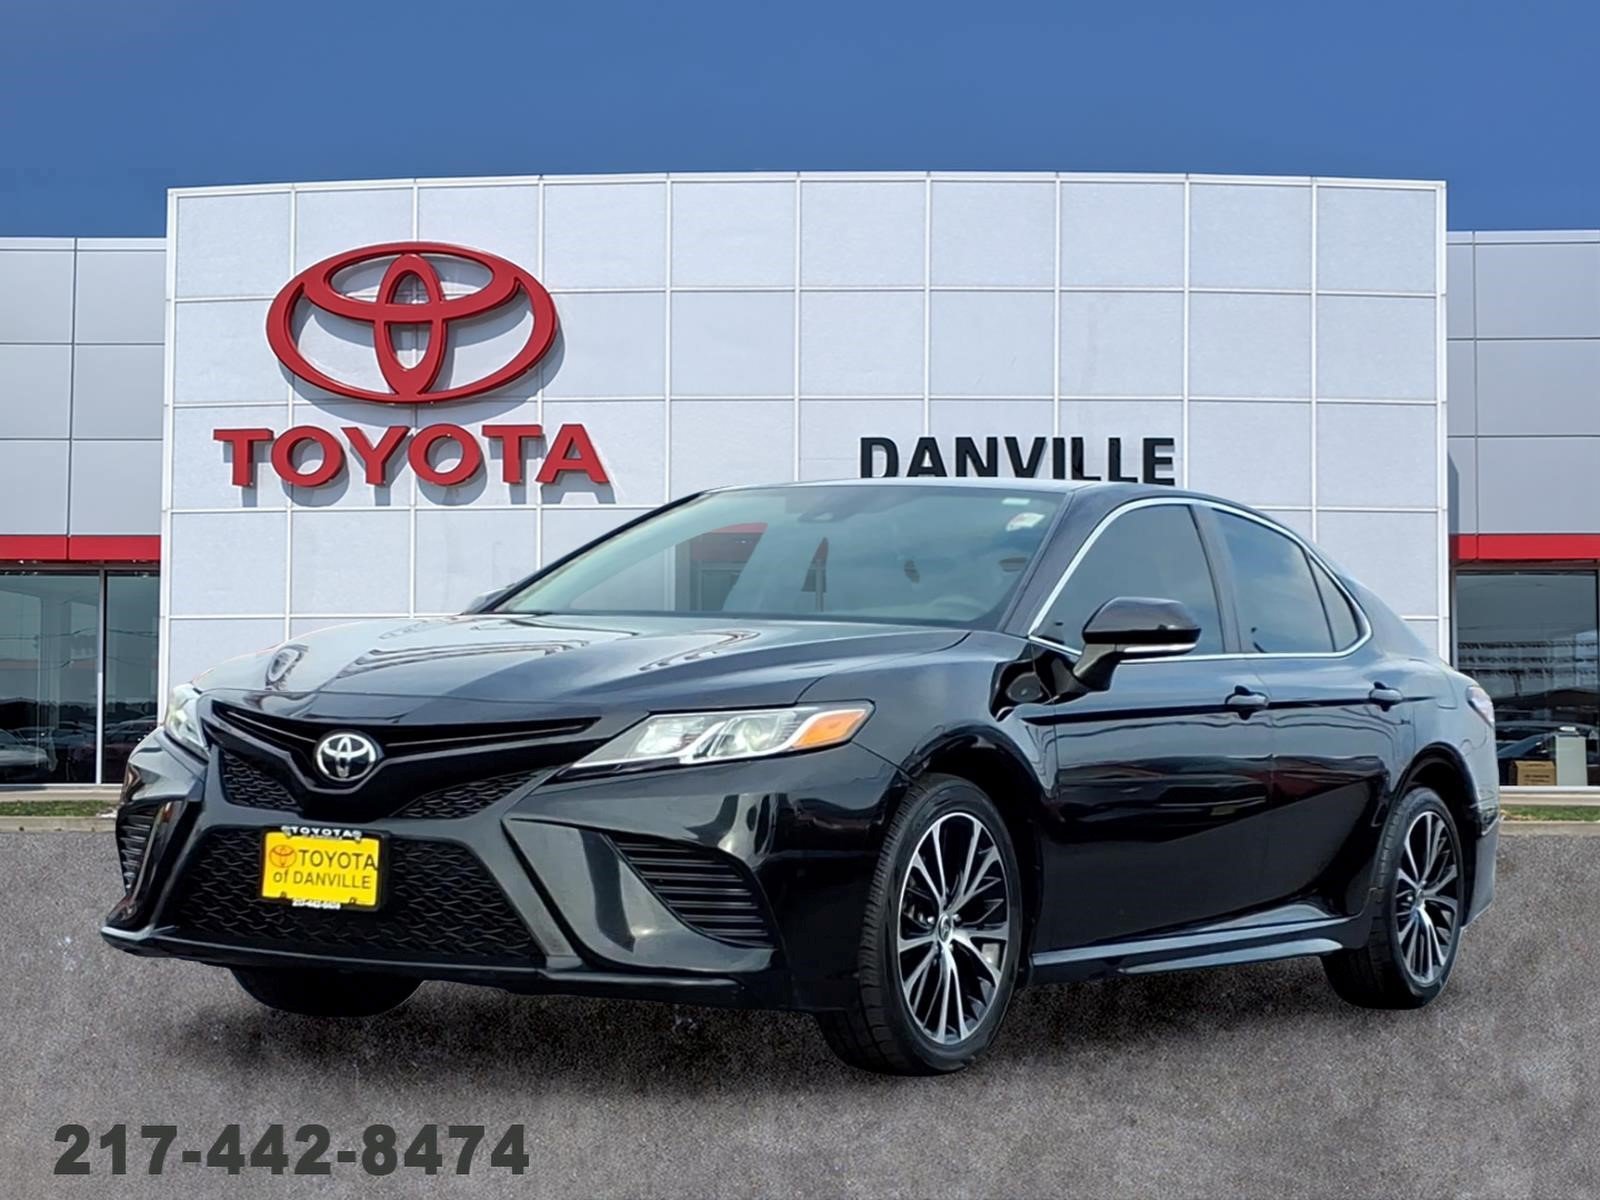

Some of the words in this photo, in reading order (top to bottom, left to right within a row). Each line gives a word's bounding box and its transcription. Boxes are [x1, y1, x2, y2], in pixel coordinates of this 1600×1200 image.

[213, 423, 611, 488] TOYOTA
[860, 436, 1176, 486] DANVILLE
[290, 826, 353, 838] TOYOTA
[298, 849, 378, 871] TOYOTA
[273, 870, 288, 884] of
[293, 871, 371, 889] DANVILLE
